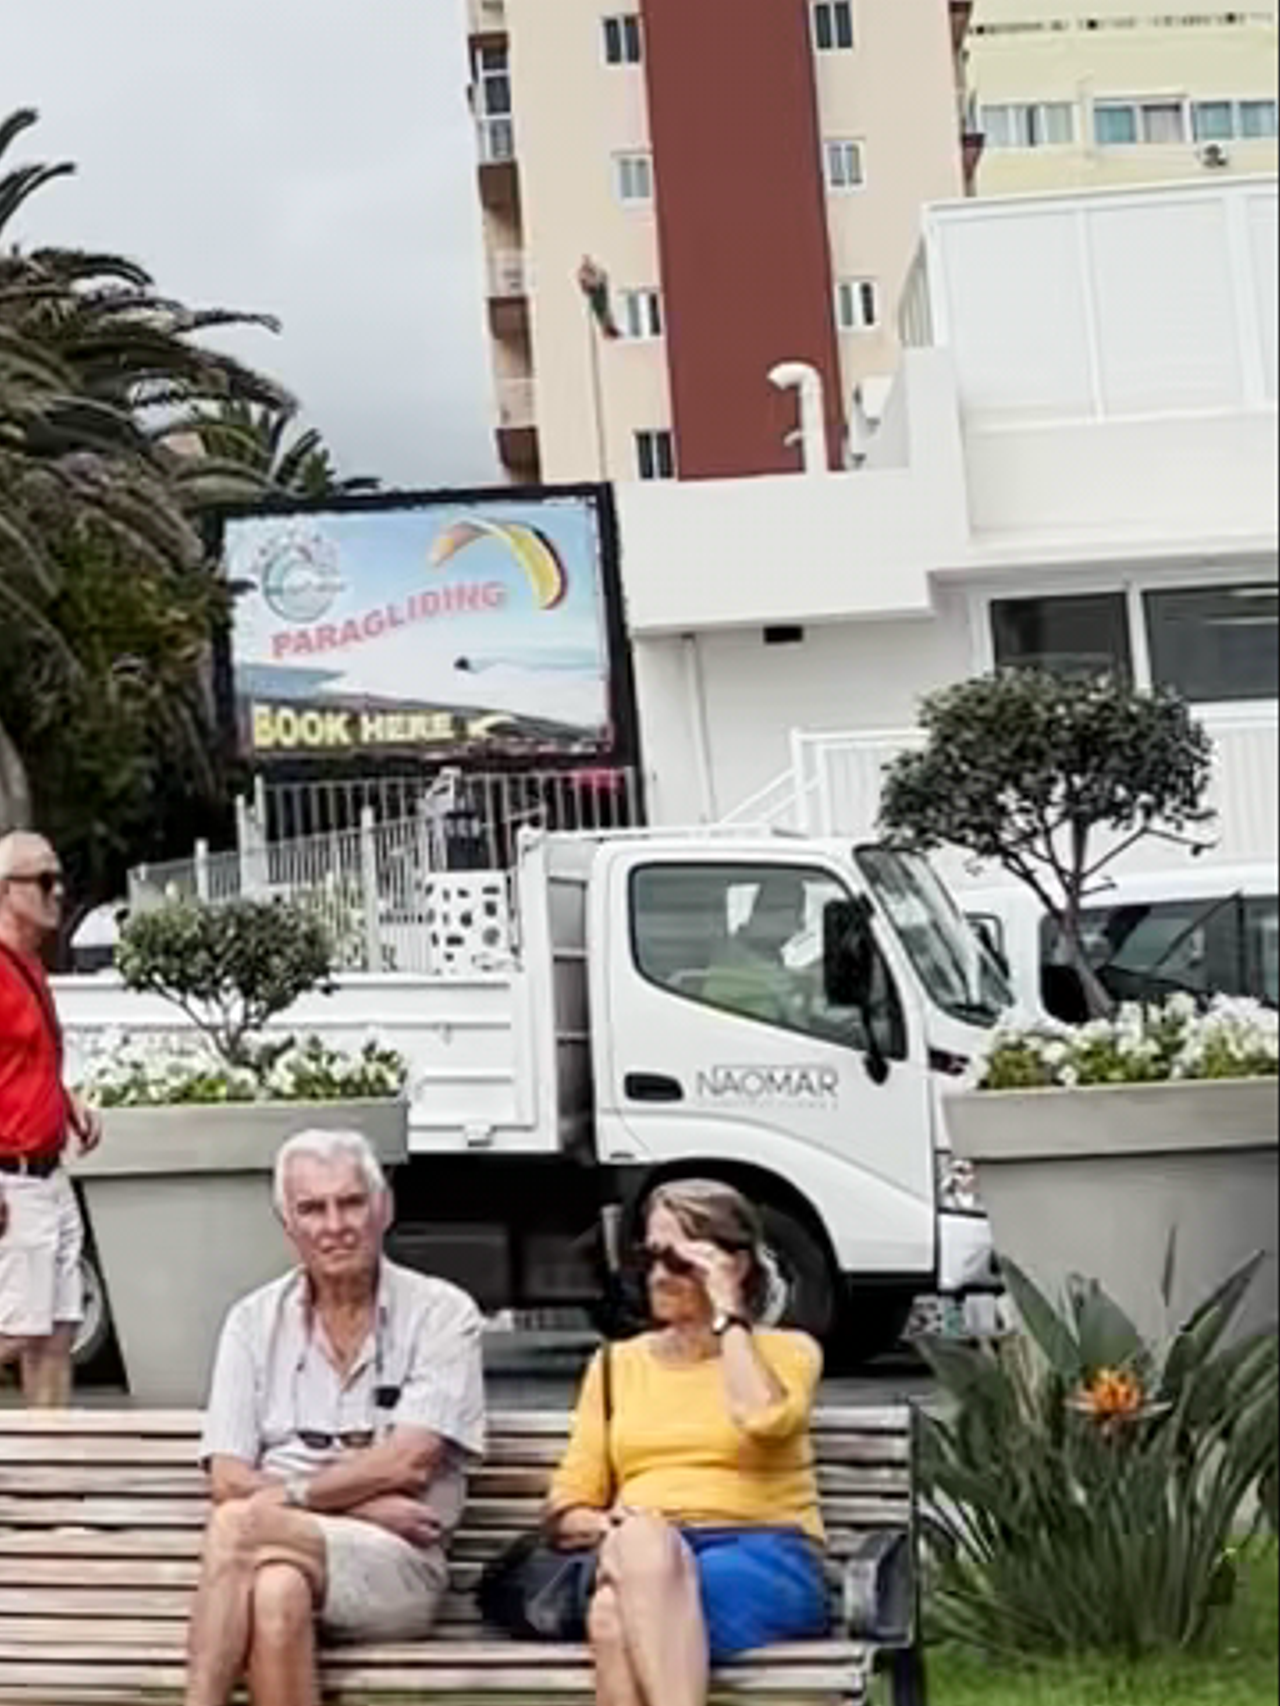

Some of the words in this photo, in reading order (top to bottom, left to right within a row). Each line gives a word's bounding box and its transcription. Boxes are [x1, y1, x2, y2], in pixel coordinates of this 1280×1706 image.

[271, 581, 507, 660] PARAGLIDING
[253, 703, 352, 749] BOOK
[360, 712, 454, 744] HERE
[696, 1064, 839, 1098] NAOMAR
